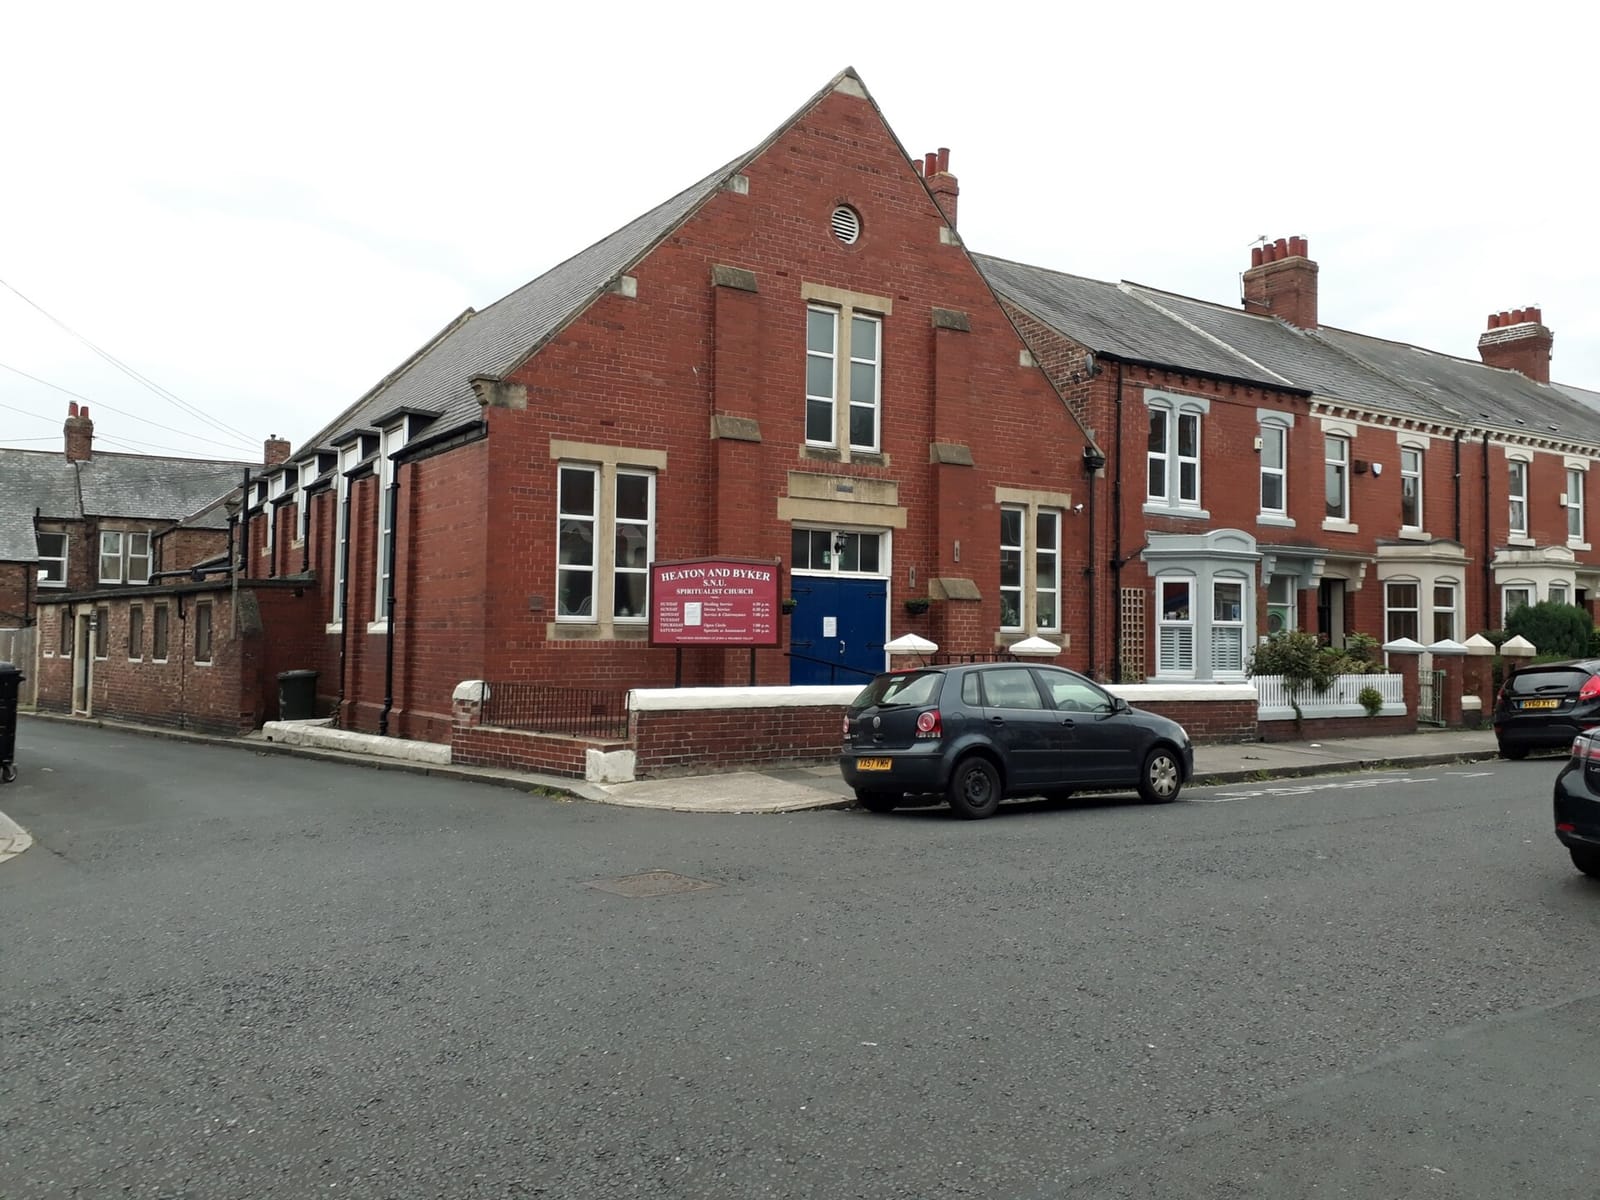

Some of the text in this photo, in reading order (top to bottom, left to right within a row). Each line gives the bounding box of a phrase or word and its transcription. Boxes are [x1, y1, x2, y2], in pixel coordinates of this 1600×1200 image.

[661, 568, 770, 582] HEATON AND BYKER
